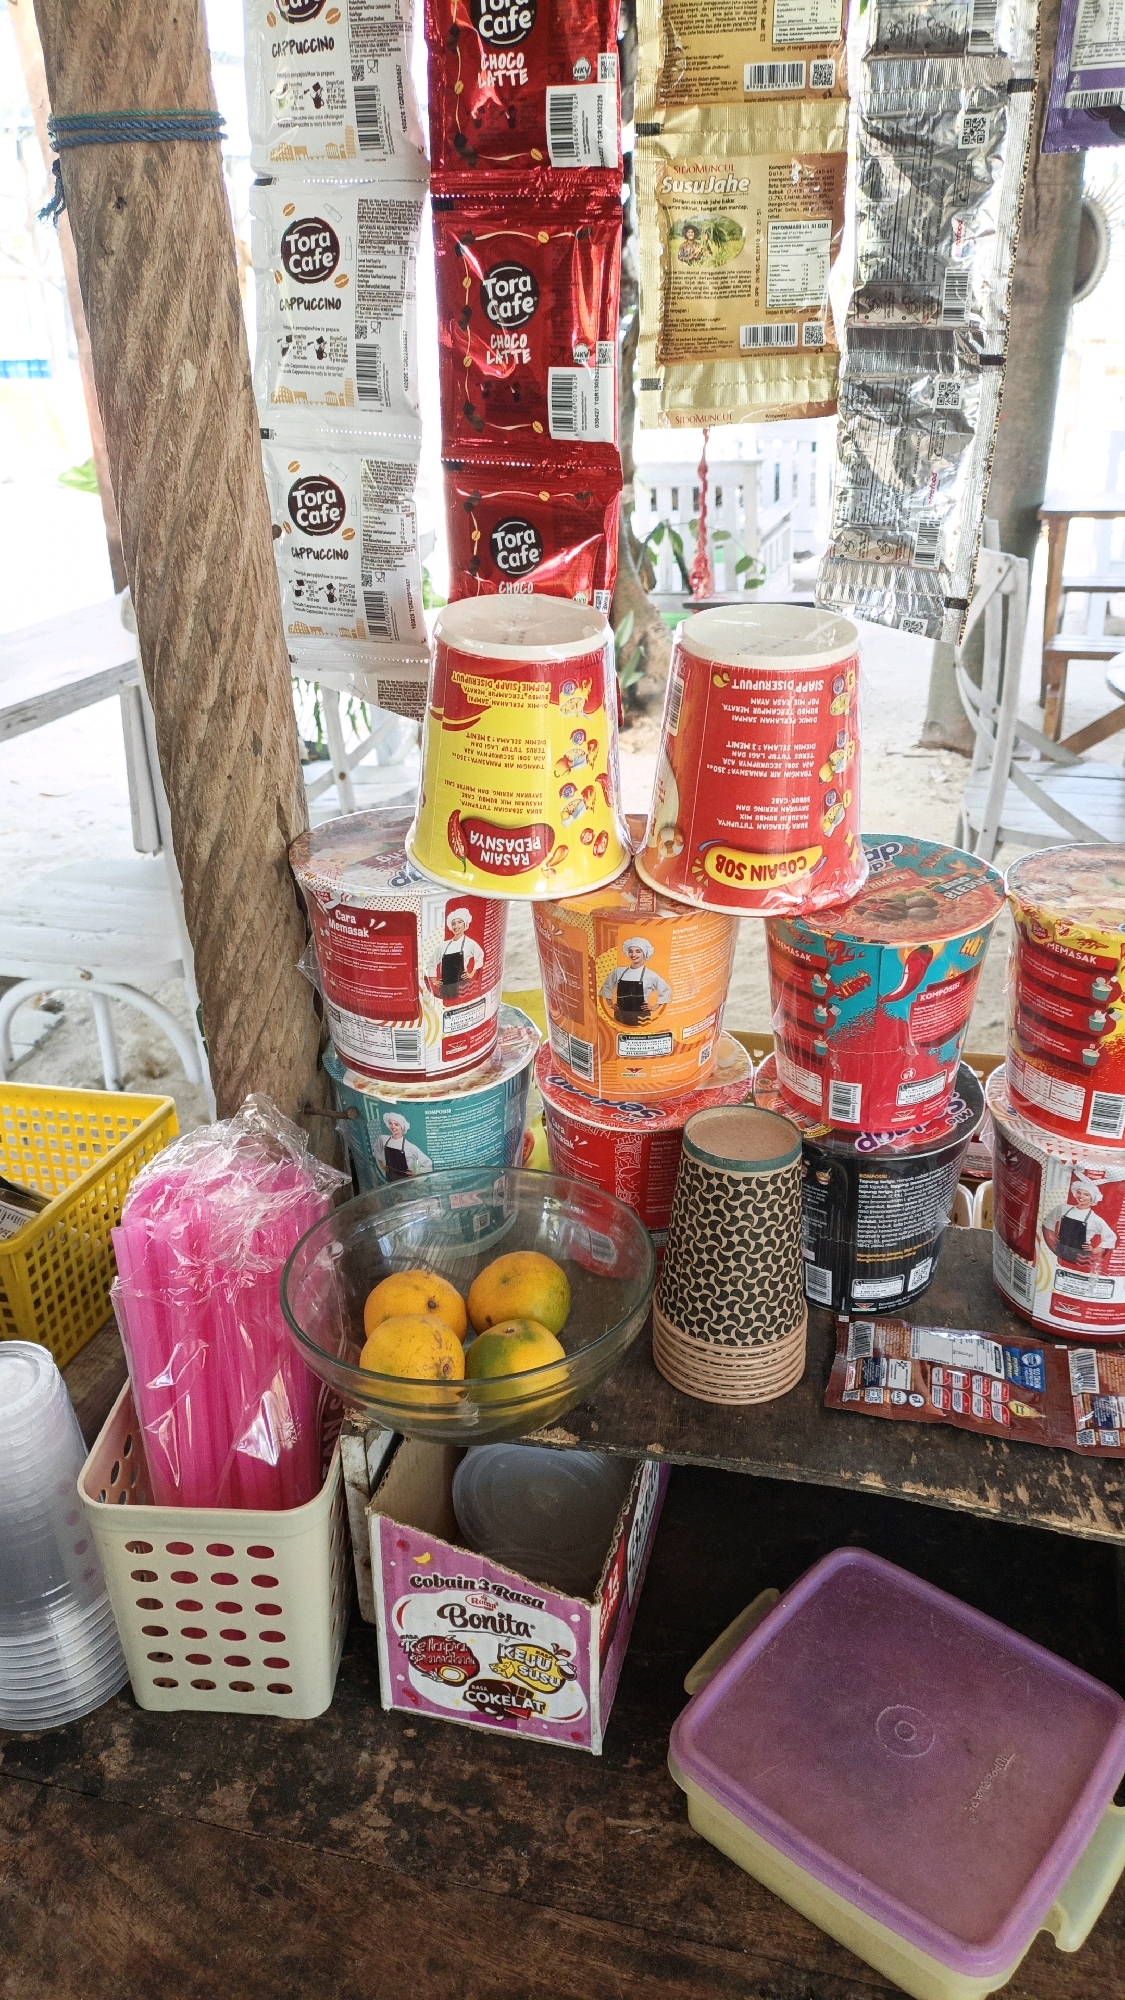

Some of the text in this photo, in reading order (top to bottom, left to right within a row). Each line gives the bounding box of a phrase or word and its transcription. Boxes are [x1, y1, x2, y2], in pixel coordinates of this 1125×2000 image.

[479, 6, 532, 38] Cafe
[272, 36, 335, 58] CAPPUCCINO
[481, 51, 525, 70] CHOCO
[477, 67, 529, 89] LATTE
[673, 164, 735, 175] SIDOMUNCUL
[286, 231, 331, 254] Tora
[288, 248, 334, 274] Cafe
[483, 275, 532, 299] Tora
[280, 296, 342, 312] CAPPUCCINO
[487, 293, 534, 321] Cafe
[490, 333, 528, 349] CHOCO
[486, 348, 531, 365] LATTE
[292, 489, 337, 509] Tora
[297, 504, 341, 527] Cafe
[492, 529, 536, 551] Tora
[291, 547, 349, 561] CAPPUCCINO
[497, 544, 540, 569] Cafe
[498, 581, 534, 594] CHOCO
[452, 672, 549, 691] POPMIE SIAPP DISERUPUUT
[731, 679, 824, 692] SIAPP DISERUPUUT
[488, 691, 524, 699] TERCAMPUR
[491, 699, 524, 708] PERLAHAN
[753, 706, 794, 715] TERCAMPUR
[797, 707, 818, 715] BUMBU
[732, 715, 757, 723] SAMPAI
[760, 717, 796, 725] PERLAHAN
[470, 741, 483, 749] DAN
[725, 740, 750, 750] MENIT
[763, 743, 791, 751] SELAMA
[794, 742, 816, 750] DIEMIN
[732, 750, 747, 758] DAN
[749, 751, 765, 759] LAGI
[768, 752, 791, 760] TUTUP
[738, 759, 782, 768] SECUKUPNYA
[802, 760, 815, 768] AJA
[731, 768, 767, 778] PANASNYA
[770, 770, 781, 778] AIR
[783, 770, 813, 778] TUANGIN
[494, 806, 523, 814] SEBAGIAN
[735, 804, 751, 812] DAN
[780, 805, 810, 813] SAYURAN
[755, 814, 778, 822] BUMBU
[469, 830, 541, 853] PEDASNYA
[481, 849, 530, 866] RASAIN
[715, 853, 807, 881] COBAIN SOB
[335, 910, 356, 924] Cara
[328, 918, 369, 938] Memasak
[1047, 941, 1097, 965] MEMASAK
[920, 982, 960, 1001] KOMPOSISI
[479, 1579, 489, 1590] 3
[491, 1584, 545, 1609] Rasa
[437, 1603, 532, 1639] Bonita
[401, 1637, 468, 1654] Kelapa
[500, 1644, 552, 1671] KEJU
[518, 1665, 561, 1687] SUSU
[465, 1691, 546, 1714] COKELAT
